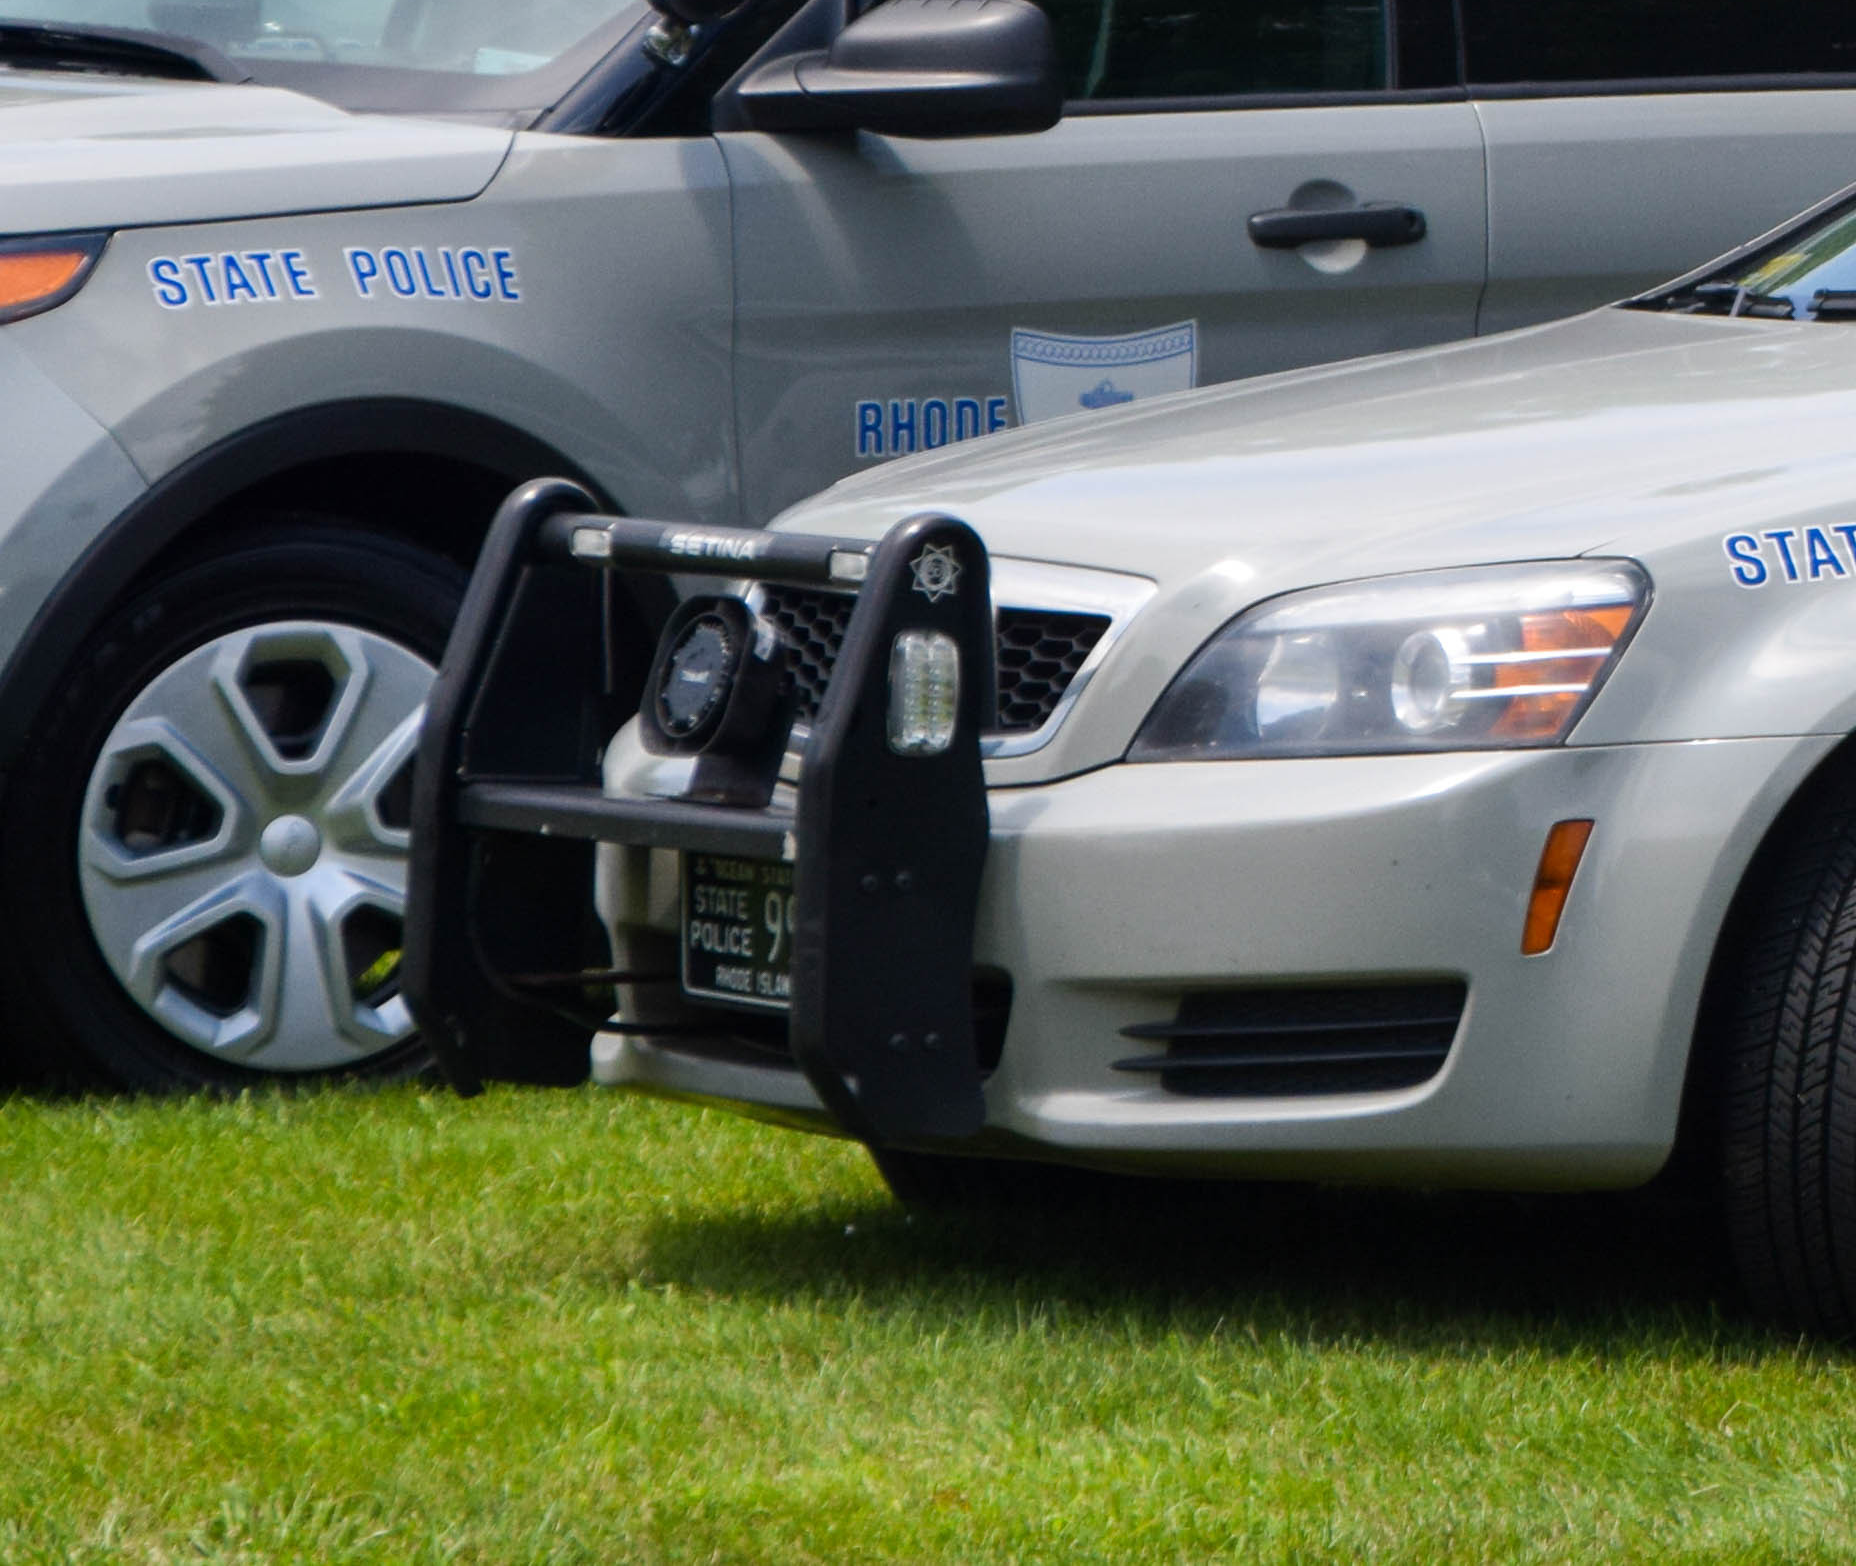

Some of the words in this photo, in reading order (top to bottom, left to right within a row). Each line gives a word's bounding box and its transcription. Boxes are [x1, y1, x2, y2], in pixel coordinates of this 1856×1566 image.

[145, 249, 318, 310] STATE
[343, 246, 523, 302] POLICE
[856, 397, 1008, 457] RHODE
[670, 533, 756, 560] SETINA
[694, 884, 750, 921] STATE
[690, 920, 753, 957] POLICE
